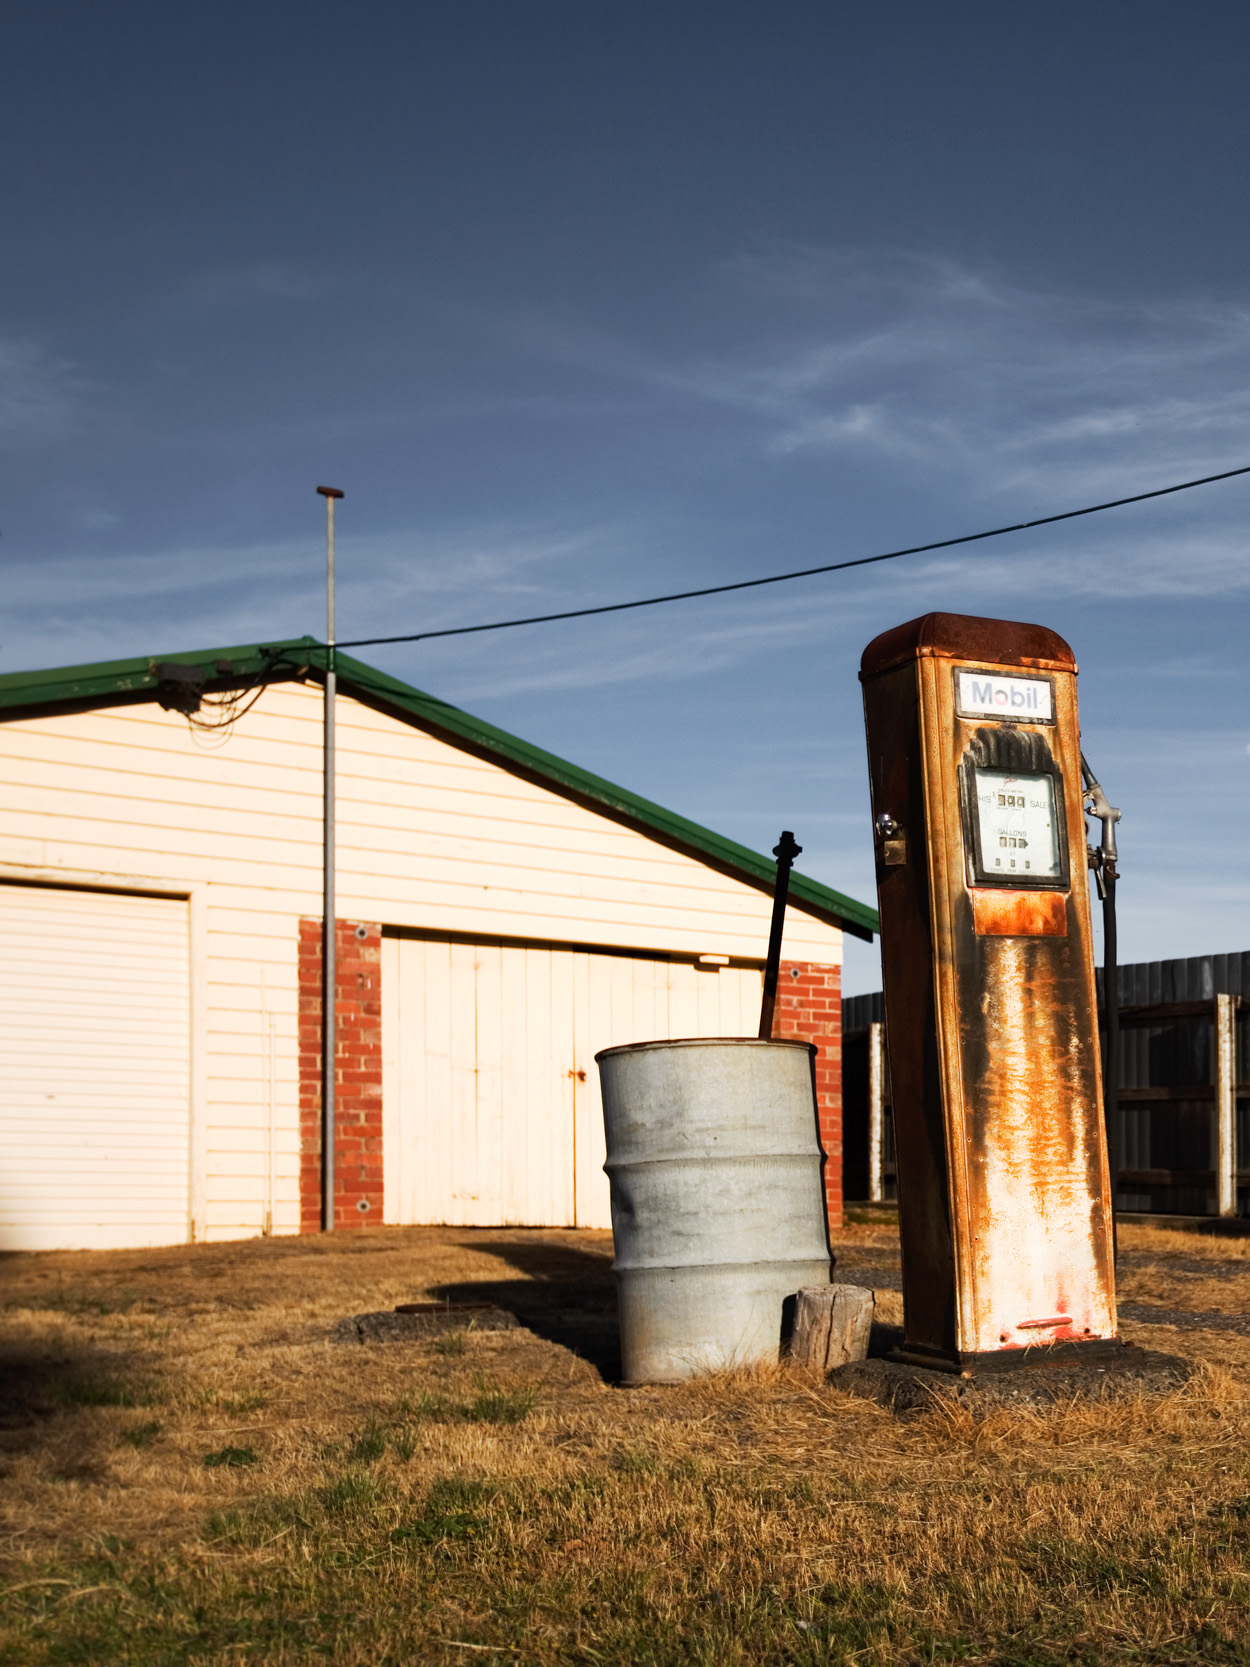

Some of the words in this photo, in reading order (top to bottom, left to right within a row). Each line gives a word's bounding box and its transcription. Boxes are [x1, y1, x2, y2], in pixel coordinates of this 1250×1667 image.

[972, 681, 1038, 709] Mobil
[1030, 800, 1047, 809] SALE
[998, 828, 1027, 837] GALLONS
